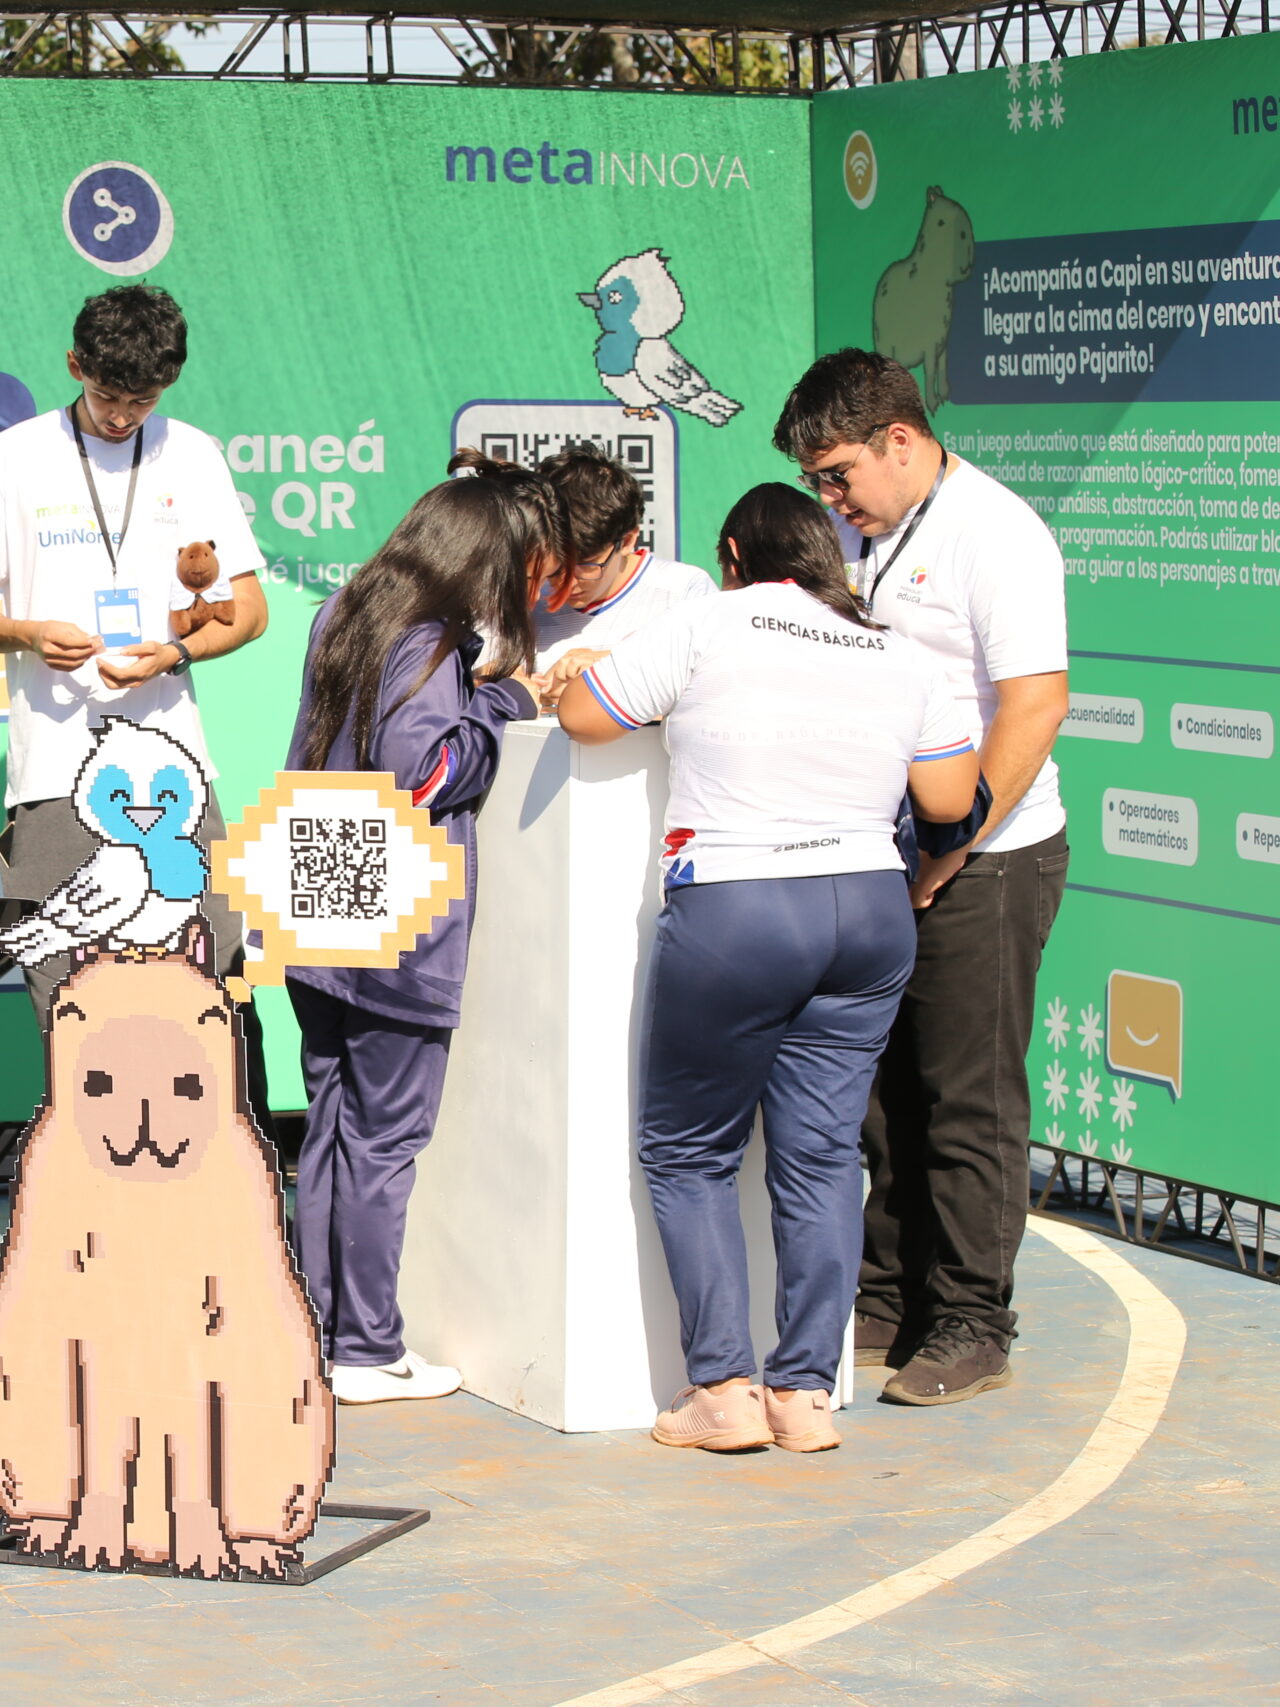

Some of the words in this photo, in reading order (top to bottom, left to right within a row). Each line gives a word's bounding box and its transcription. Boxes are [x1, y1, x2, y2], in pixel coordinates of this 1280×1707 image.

[1232, 95, 1280, 136] me
[984, 258, 1082, 301] ¡Acompañá
[1085, 266, 1097, 288] a
[1100, 254, 1142, 297] Capi
[1145, 261, 1168, 285] en
[1171, 260, 1193, 284] su
[983, 307, 1032, 345] llegar
[1034, 311, 1046, 334] a
[1049, 304, 1065, 333] la
[1068, 301, 1112, 332] cima
[1116, 300, 1143, 330] del
[1146, 304, 1195, 328] cerro
[1198, 303, 1210, 337] y
[1213, 295, 1280, 326] encont
[984, 354, 995, 377] a
[999, 354, 1019, 376] su
[1021, 344, 1076, 385] amigo
[1080, 342, 1154, 383] Pajarito!
[208, 418, 384, 473] aneá
[943, 431, 957, 451] Es
[959, 435, 975, 451] un
[976, 430, 1012, 458] juego
[1014, 429, 1079, 451] educativo
[1081, 434, 1106, 459] que
[1108, 428, 1138, 451] está
[1140, 428, 1204, 452] diseñado
[1208, 434, 1241, 460] para
[1028, 460, 1045, 482] de
[1047, 459, 1139, 483] razonamiento
[1141, 459, 1238, 491] lógico-crítico,
[271, 481, 356, 537] QR
[1058, 490, 1111, 519] análisis,
[1112, 492, 1197, 521] abstracción,
[1200, 496, 1238, 518] toma
[1240, 496, 1259, 519] de
[38, 528, 122, 548] UniNore
[1060, 523, 1158, 552] programación.
[1160, 525, 1208, 550] Podrás
[1211, 526, 1259, 552] utilizar
[1064, 558, 1087, 575] ara
[1089, 553, 1124, 584] guiar
[1127, 560, 1136, 578] a
[1138, 556, 1157, 579] los
[1160, 558, 1236, 590] personajes
[1239, 566, 1249, 585] a
[751, 616, 820, 641] CIENCIAS
[823, 630, 885, 651] BÁSICAS
[1186, 717, 1262, 741] Condicionales
[1119, 800, 1179, 823] Operadores
[1119, 827, 1188, 850] matemáticos
